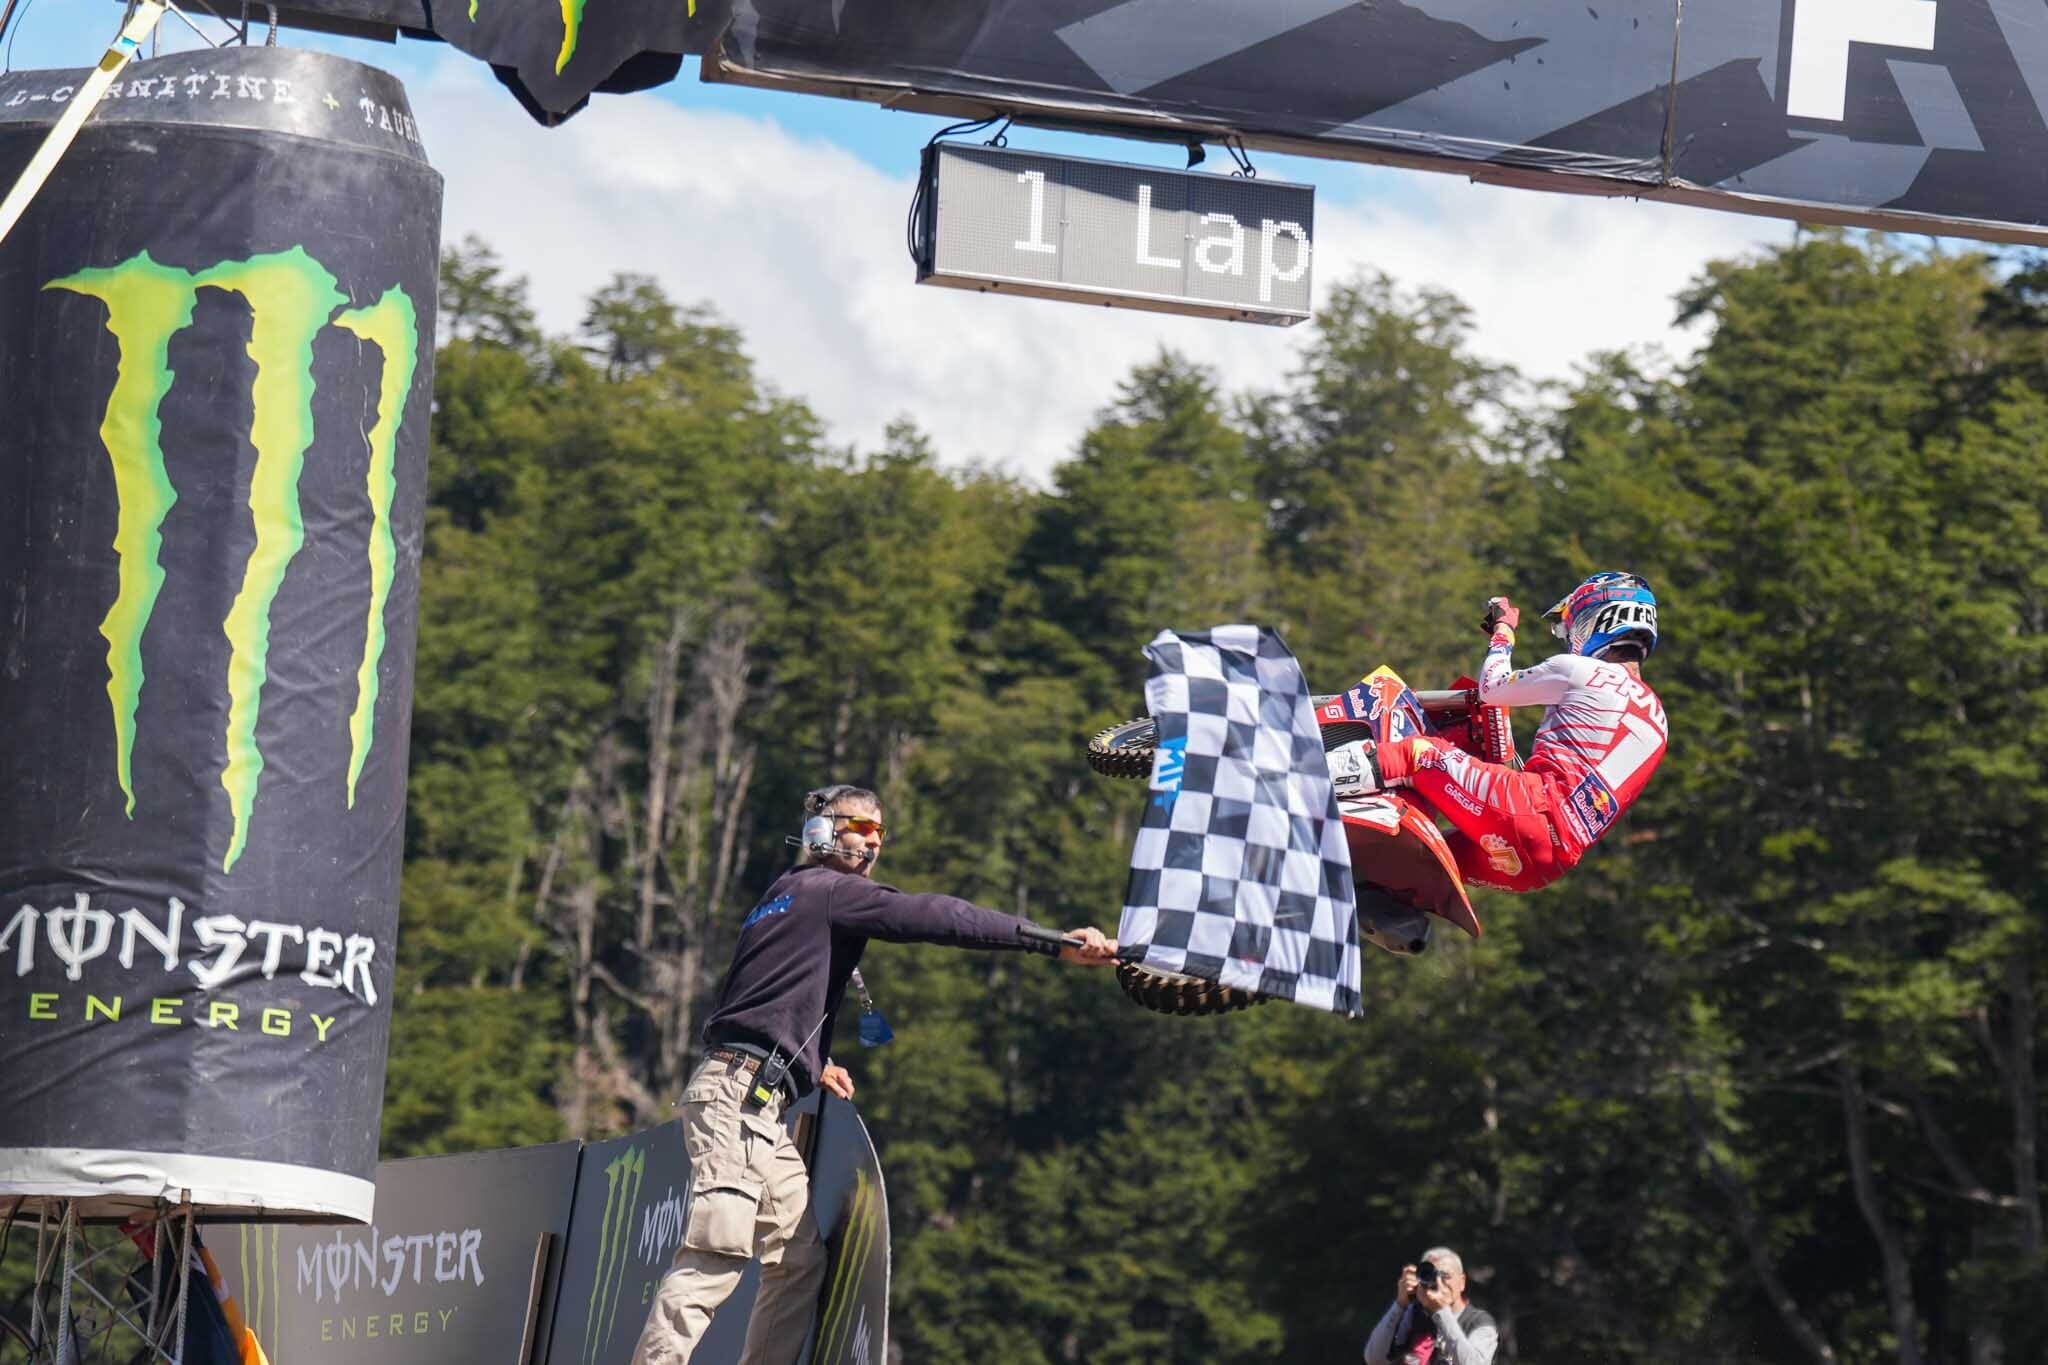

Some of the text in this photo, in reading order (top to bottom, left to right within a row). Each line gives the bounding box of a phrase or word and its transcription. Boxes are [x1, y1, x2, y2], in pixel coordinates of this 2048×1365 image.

[5, 66, 296, 108] L-CRNITINE
[1014, 170, 1311, 302] 1 Lap
[1596, 712, 1664, 791] 1
[1444, 783, 1484, 817] GASGAS
[29, 993, 336, 1042] ENERGY
[297, 1225, 485, 1305] MONSTER
